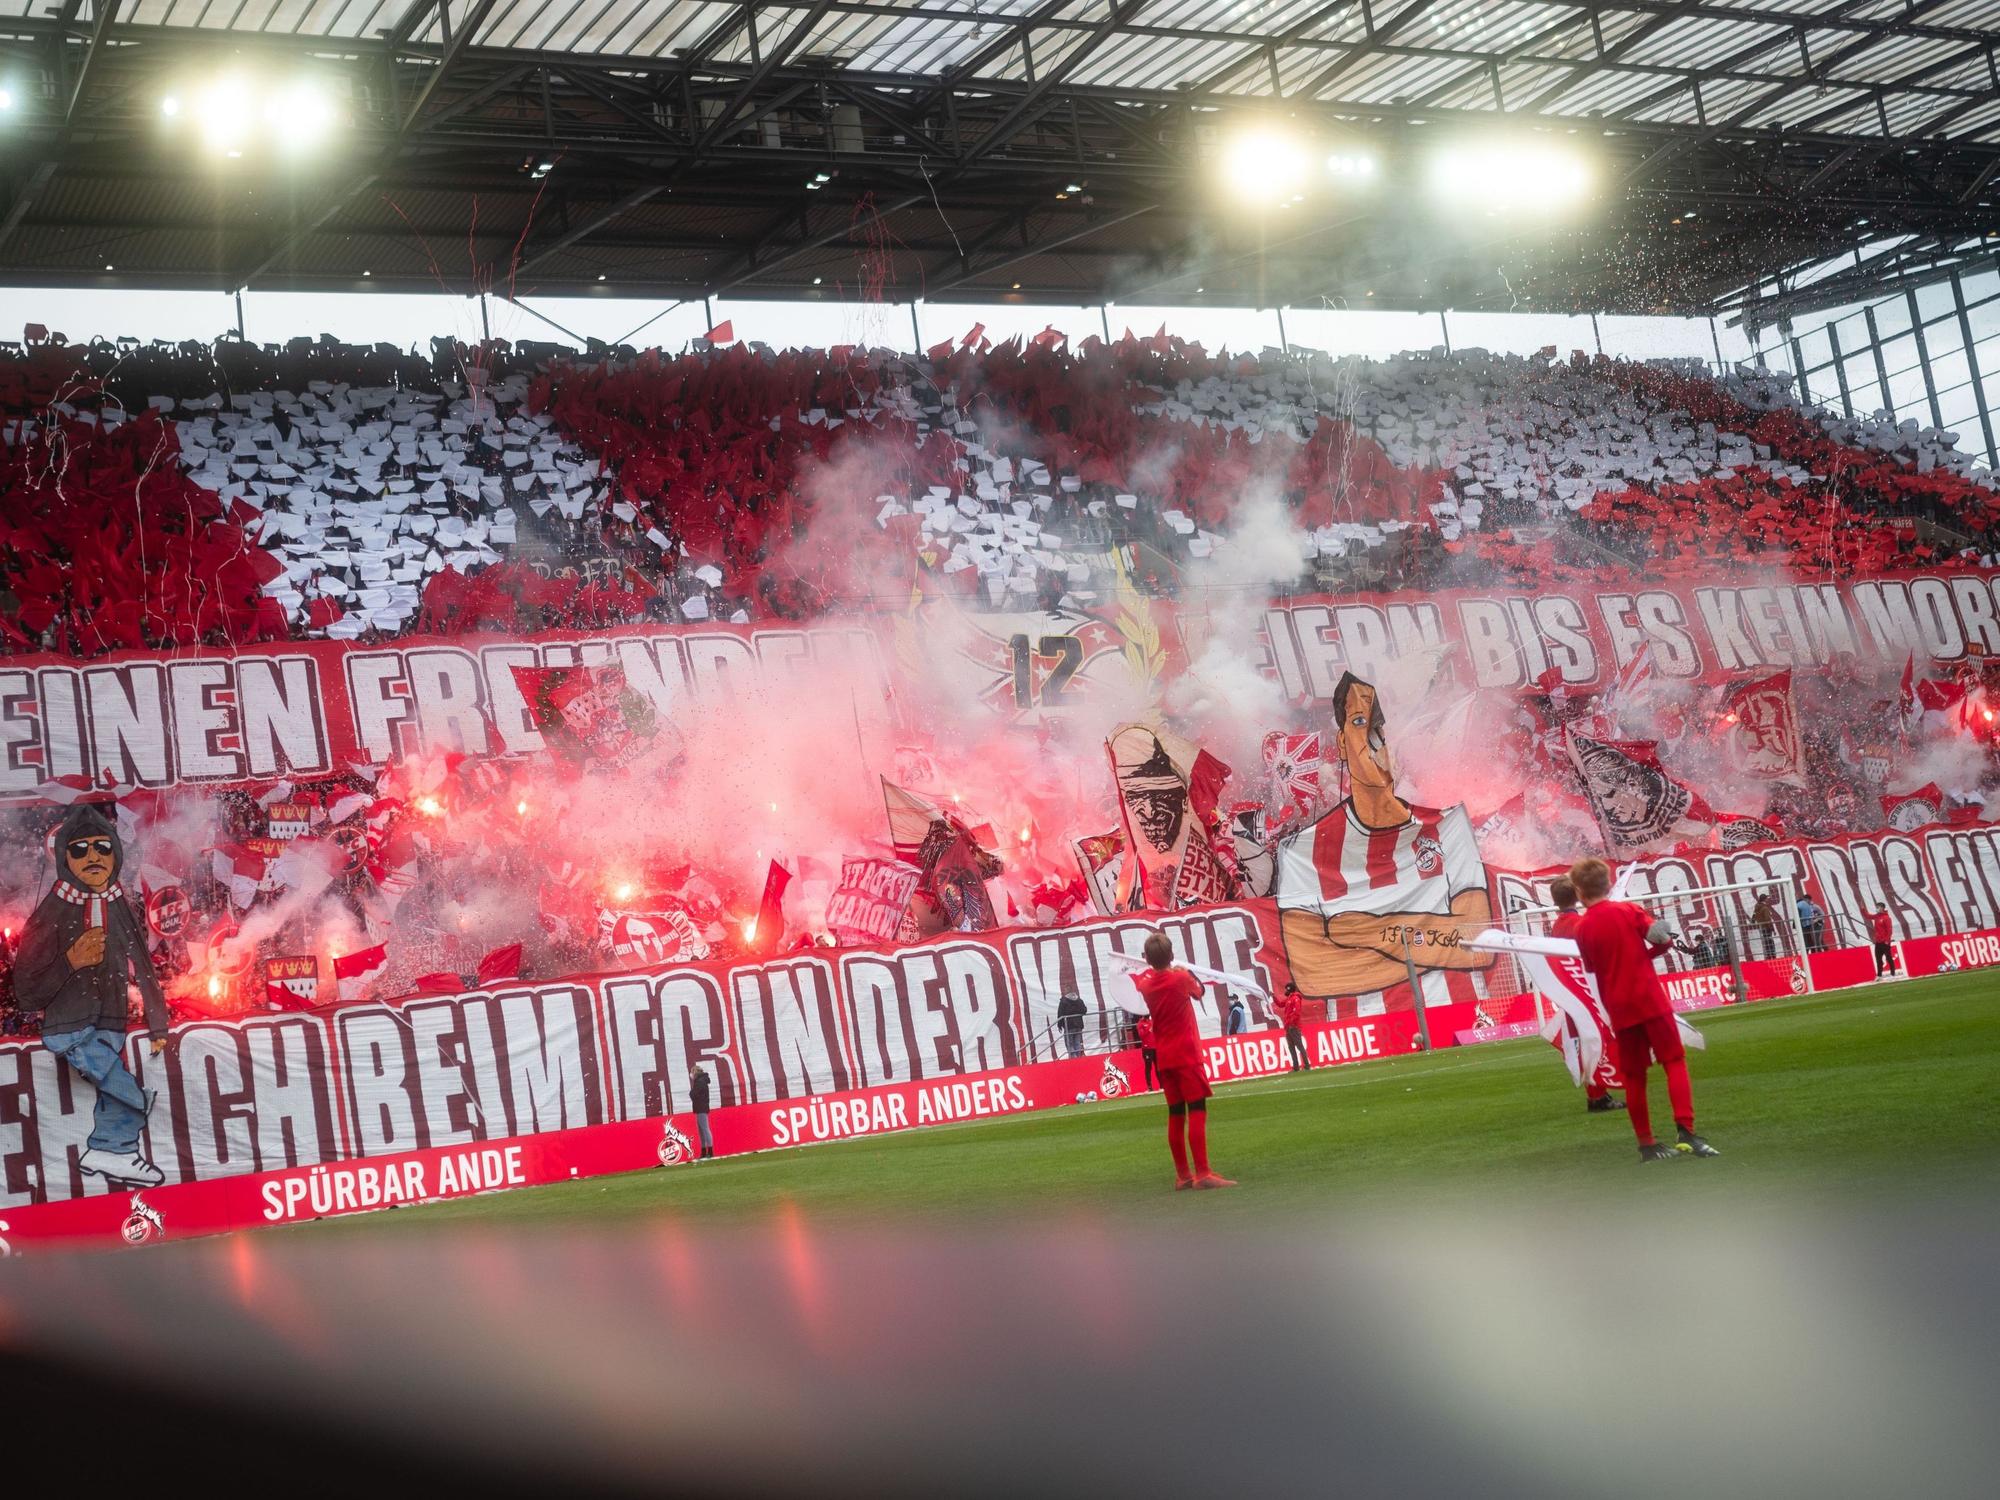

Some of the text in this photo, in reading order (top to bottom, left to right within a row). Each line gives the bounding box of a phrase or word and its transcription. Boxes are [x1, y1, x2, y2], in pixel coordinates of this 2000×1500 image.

[1008, 633, 1084, 709] 12
[1178, 576, 2000, 699] IERN BIS ES KEIN MOR
[346, 629, 886, 768] FREND
[1810, 835, 1943, 952] DAS
[340, 988, 599, 1160] BEIM
[606, 971, 735, 1122] FC
[735, 961, 849, 1105] IN
[844, 944, 1018, 1089] DER
[770, 1075, 1034, 1145] SPÜRBAR ANDERS.
[262, 1161, 428, 1221] SPÜRBAR
